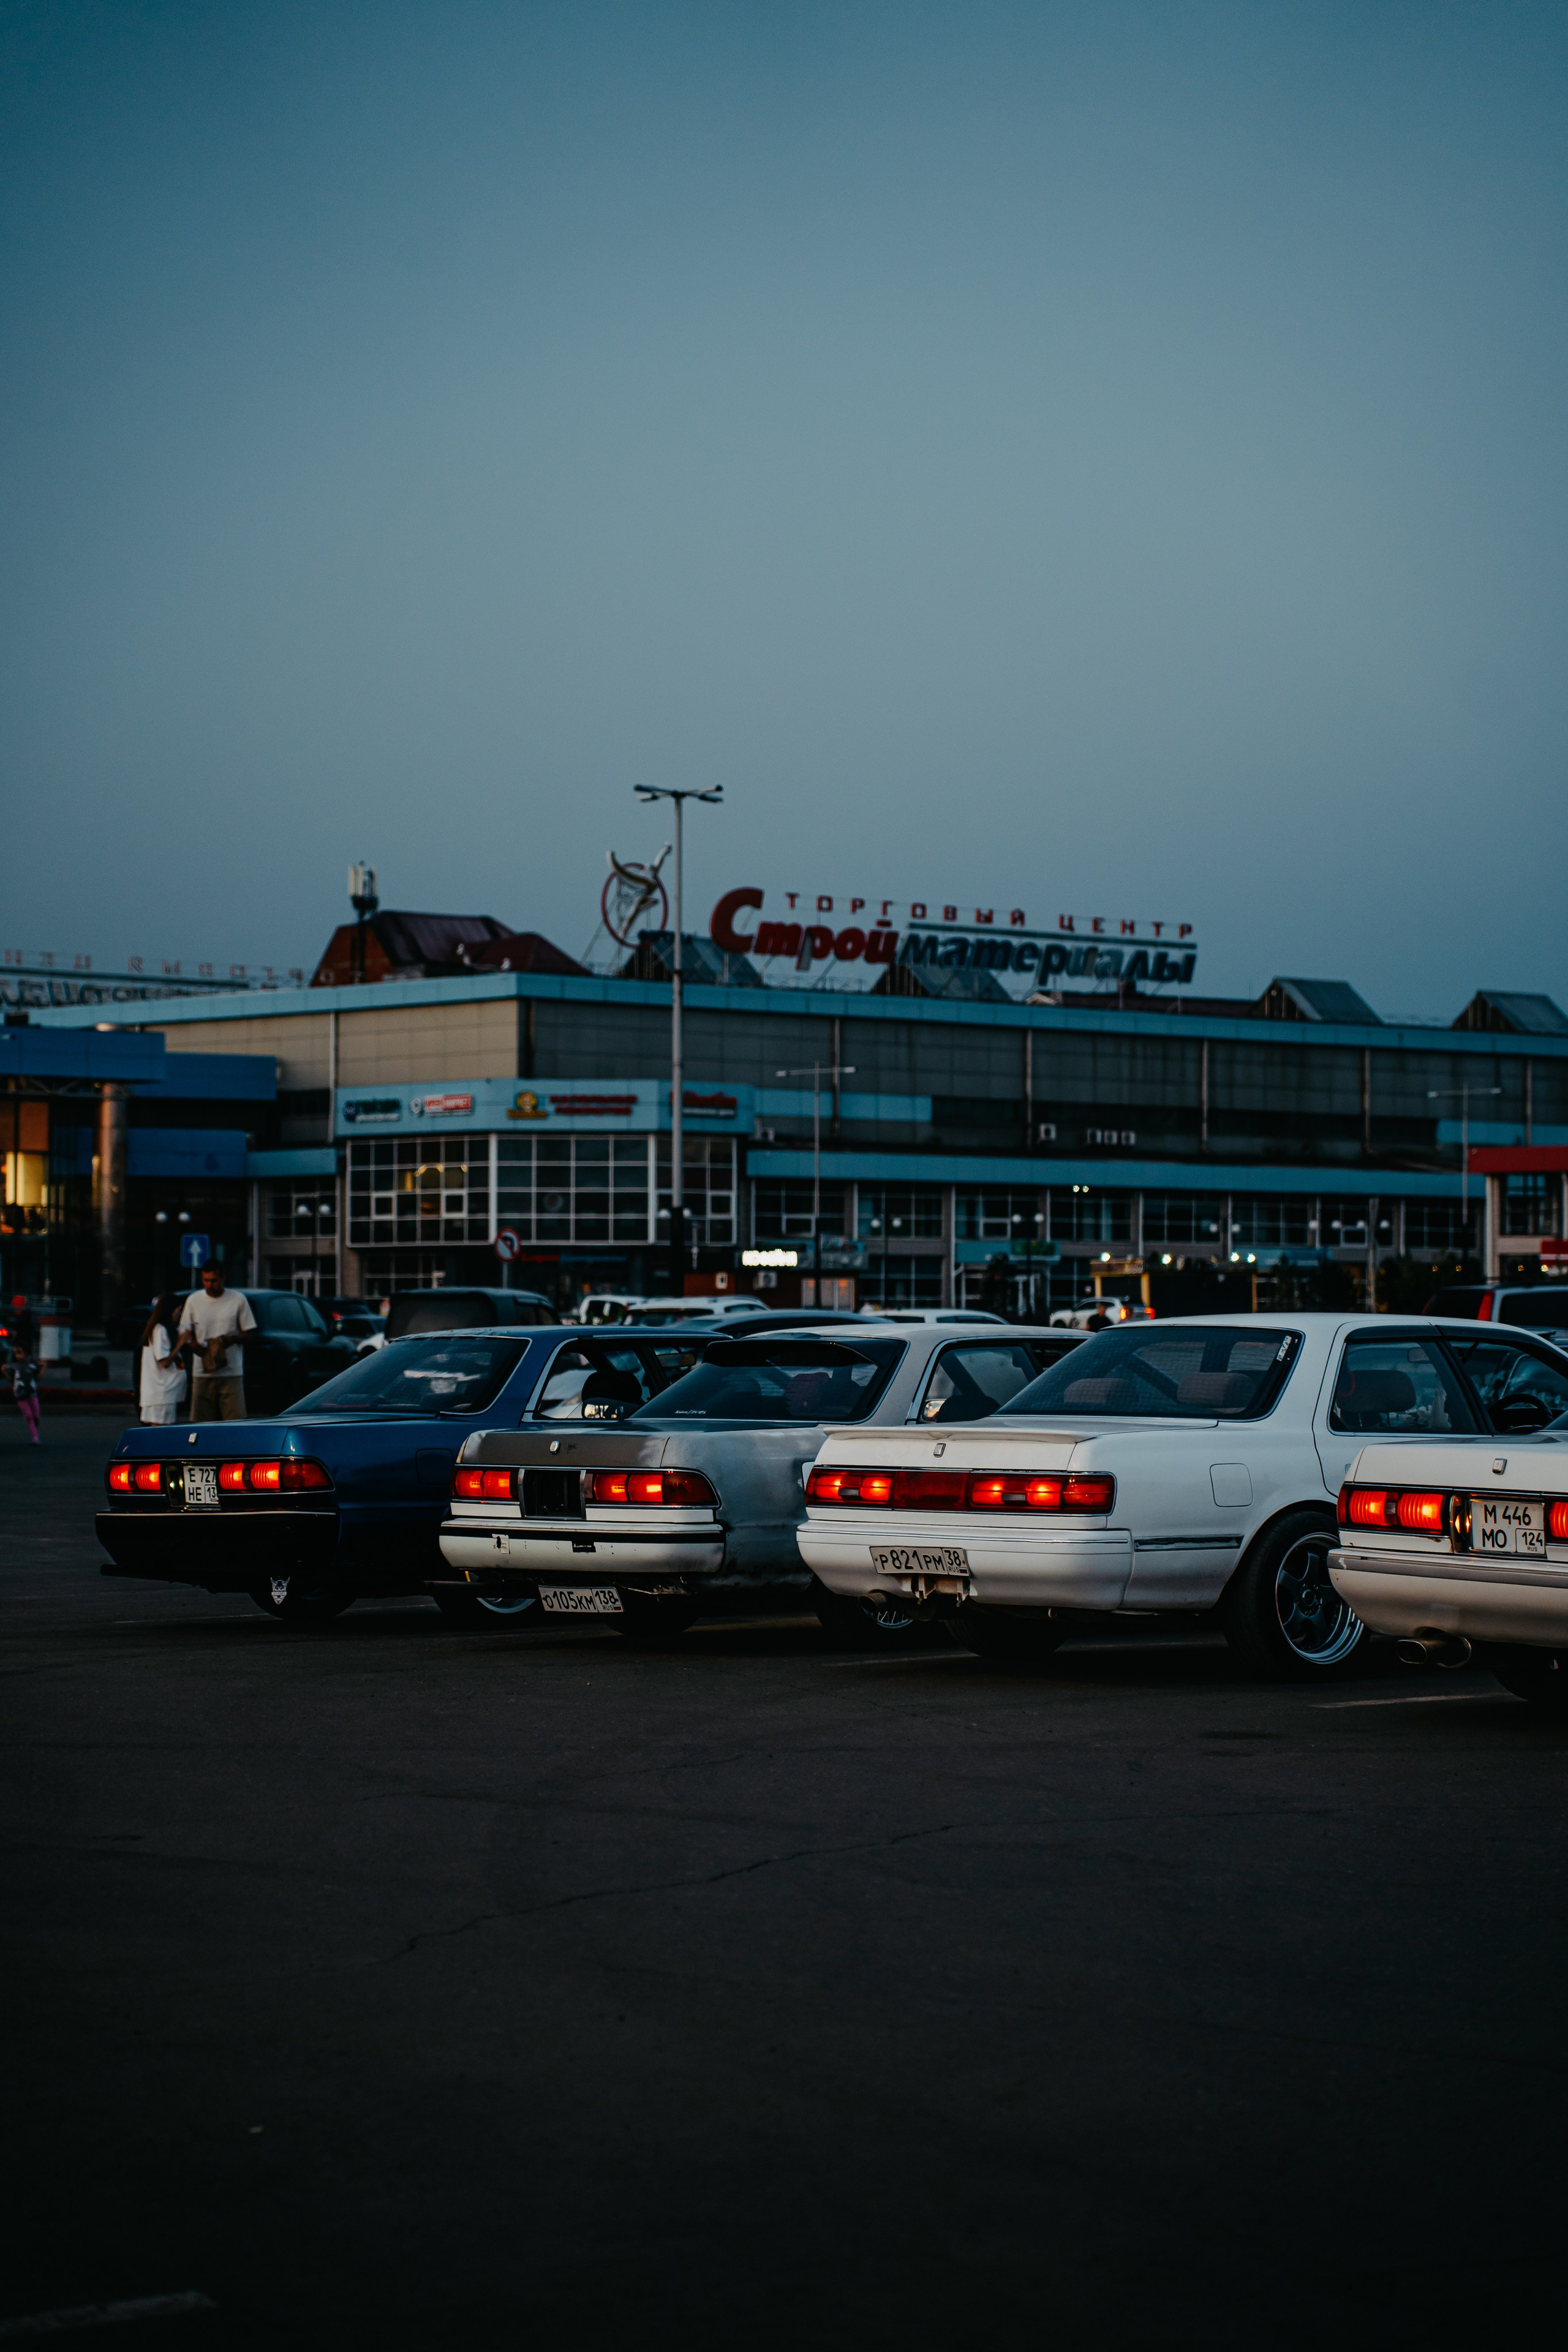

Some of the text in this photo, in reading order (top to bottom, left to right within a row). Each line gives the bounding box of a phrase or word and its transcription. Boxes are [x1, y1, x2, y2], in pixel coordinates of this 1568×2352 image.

[785, 891, 1193, 938] ТОРГОВЫЙ ЦЕНТР
[1482, 1528, 1543, 1548] МО 124
[944, 1550, 962, 1566] 38
[595, 1590, 616, 1605] 138
